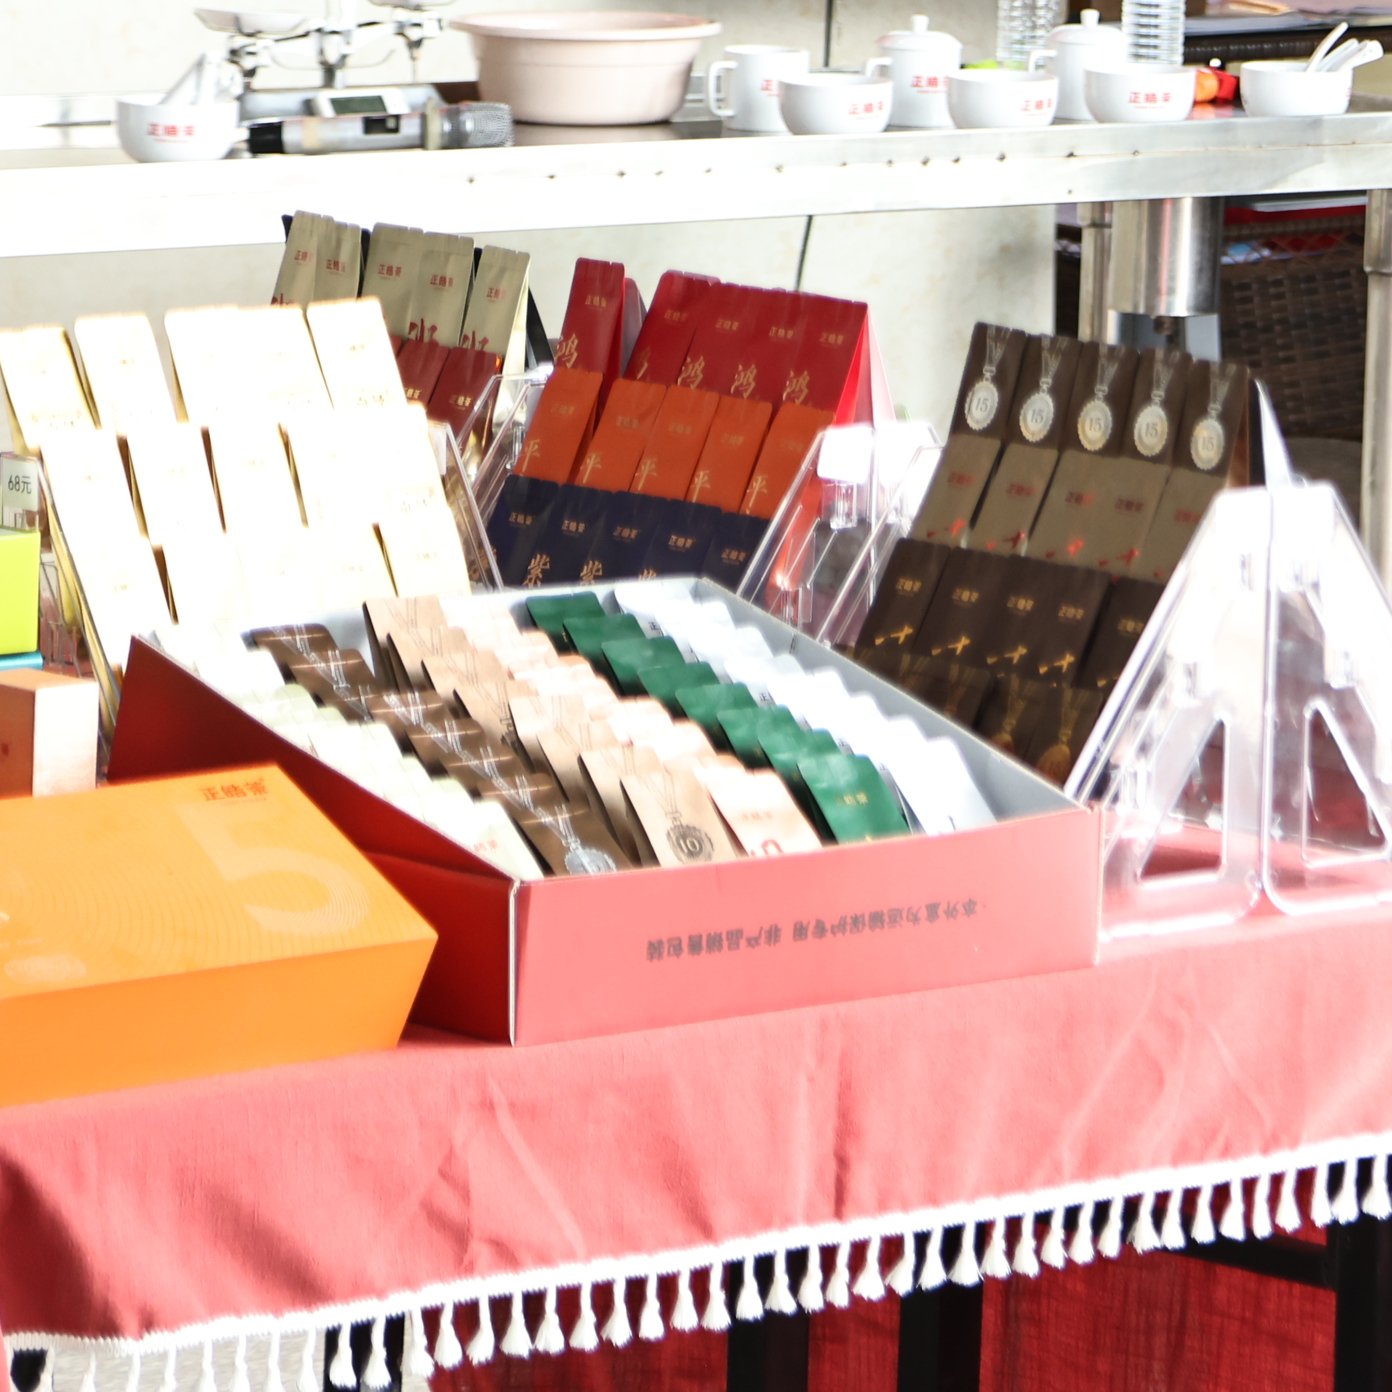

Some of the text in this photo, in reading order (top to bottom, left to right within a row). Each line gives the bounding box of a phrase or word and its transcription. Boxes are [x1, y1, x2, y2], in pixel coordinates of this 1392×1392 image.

[975, 396, 989, 412] 15
[1030, 409, 1044, 424] 15
[1088, 417, 1102, 432] 15
[1144, 423, 1158, 436] 15
[1201, 436, 1215, 450] 15
[7, 474, 32, 495] 68元
[198, 778, 270, 802] 正皓茶
[679, 837, 700, 854] 10
[176, 803, 370, 936] 5
